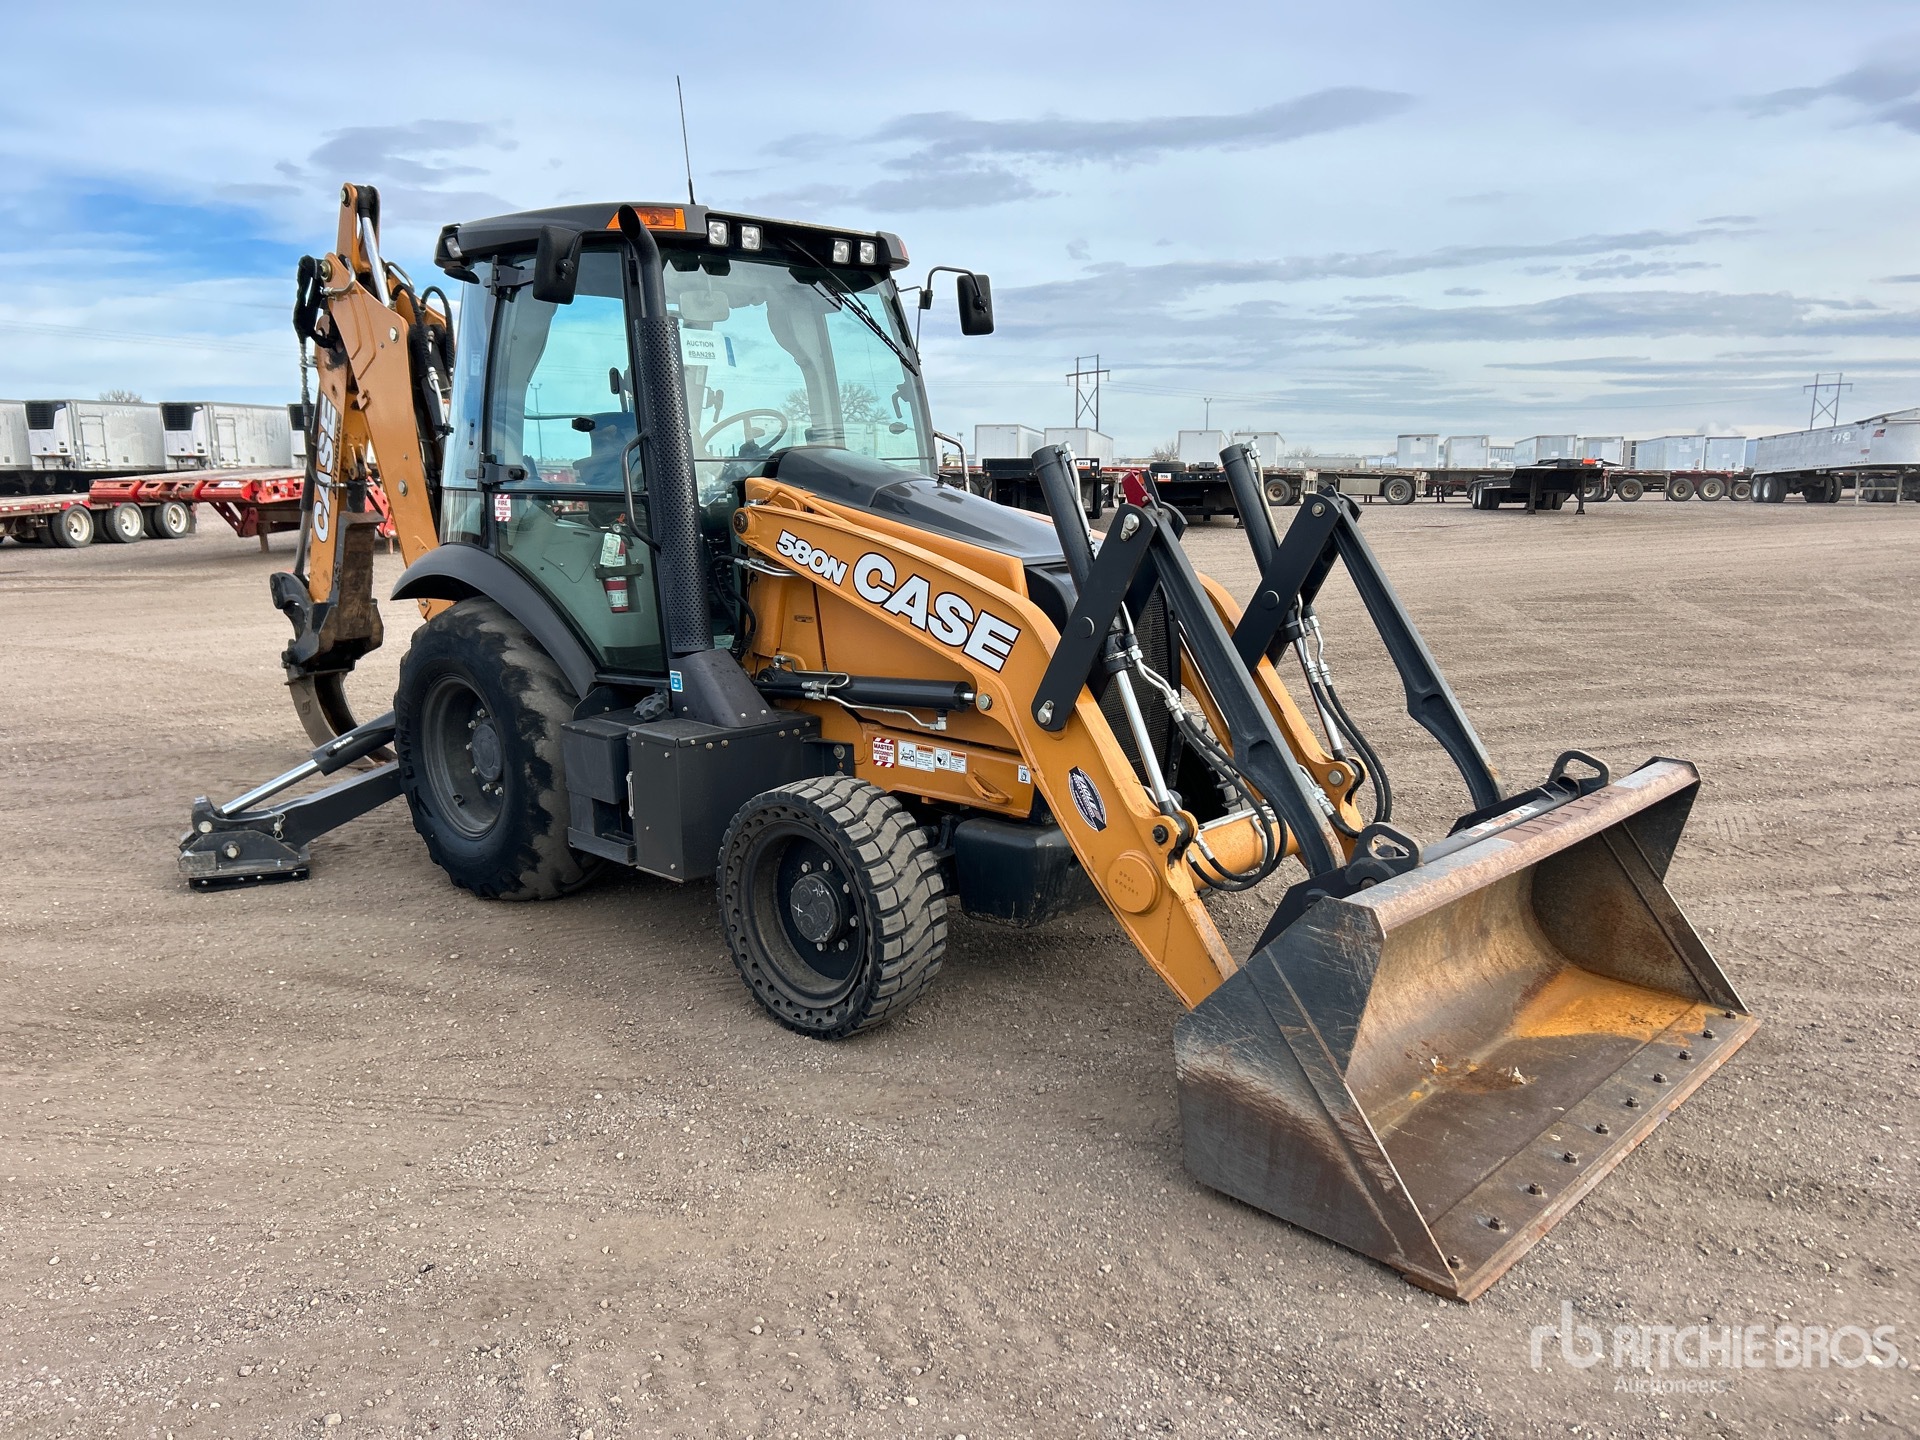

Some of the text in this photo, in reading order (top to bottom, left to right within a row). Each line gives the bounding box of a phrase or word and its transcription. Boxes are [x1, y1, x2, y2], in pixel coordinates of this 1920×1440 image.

[686, 340, 714, 348] AUCTION
[314, 391, 337, 543] CASE
[776, 529, 1022, 673] 580N CASE
[873, 743, 893, 751] MASTER
